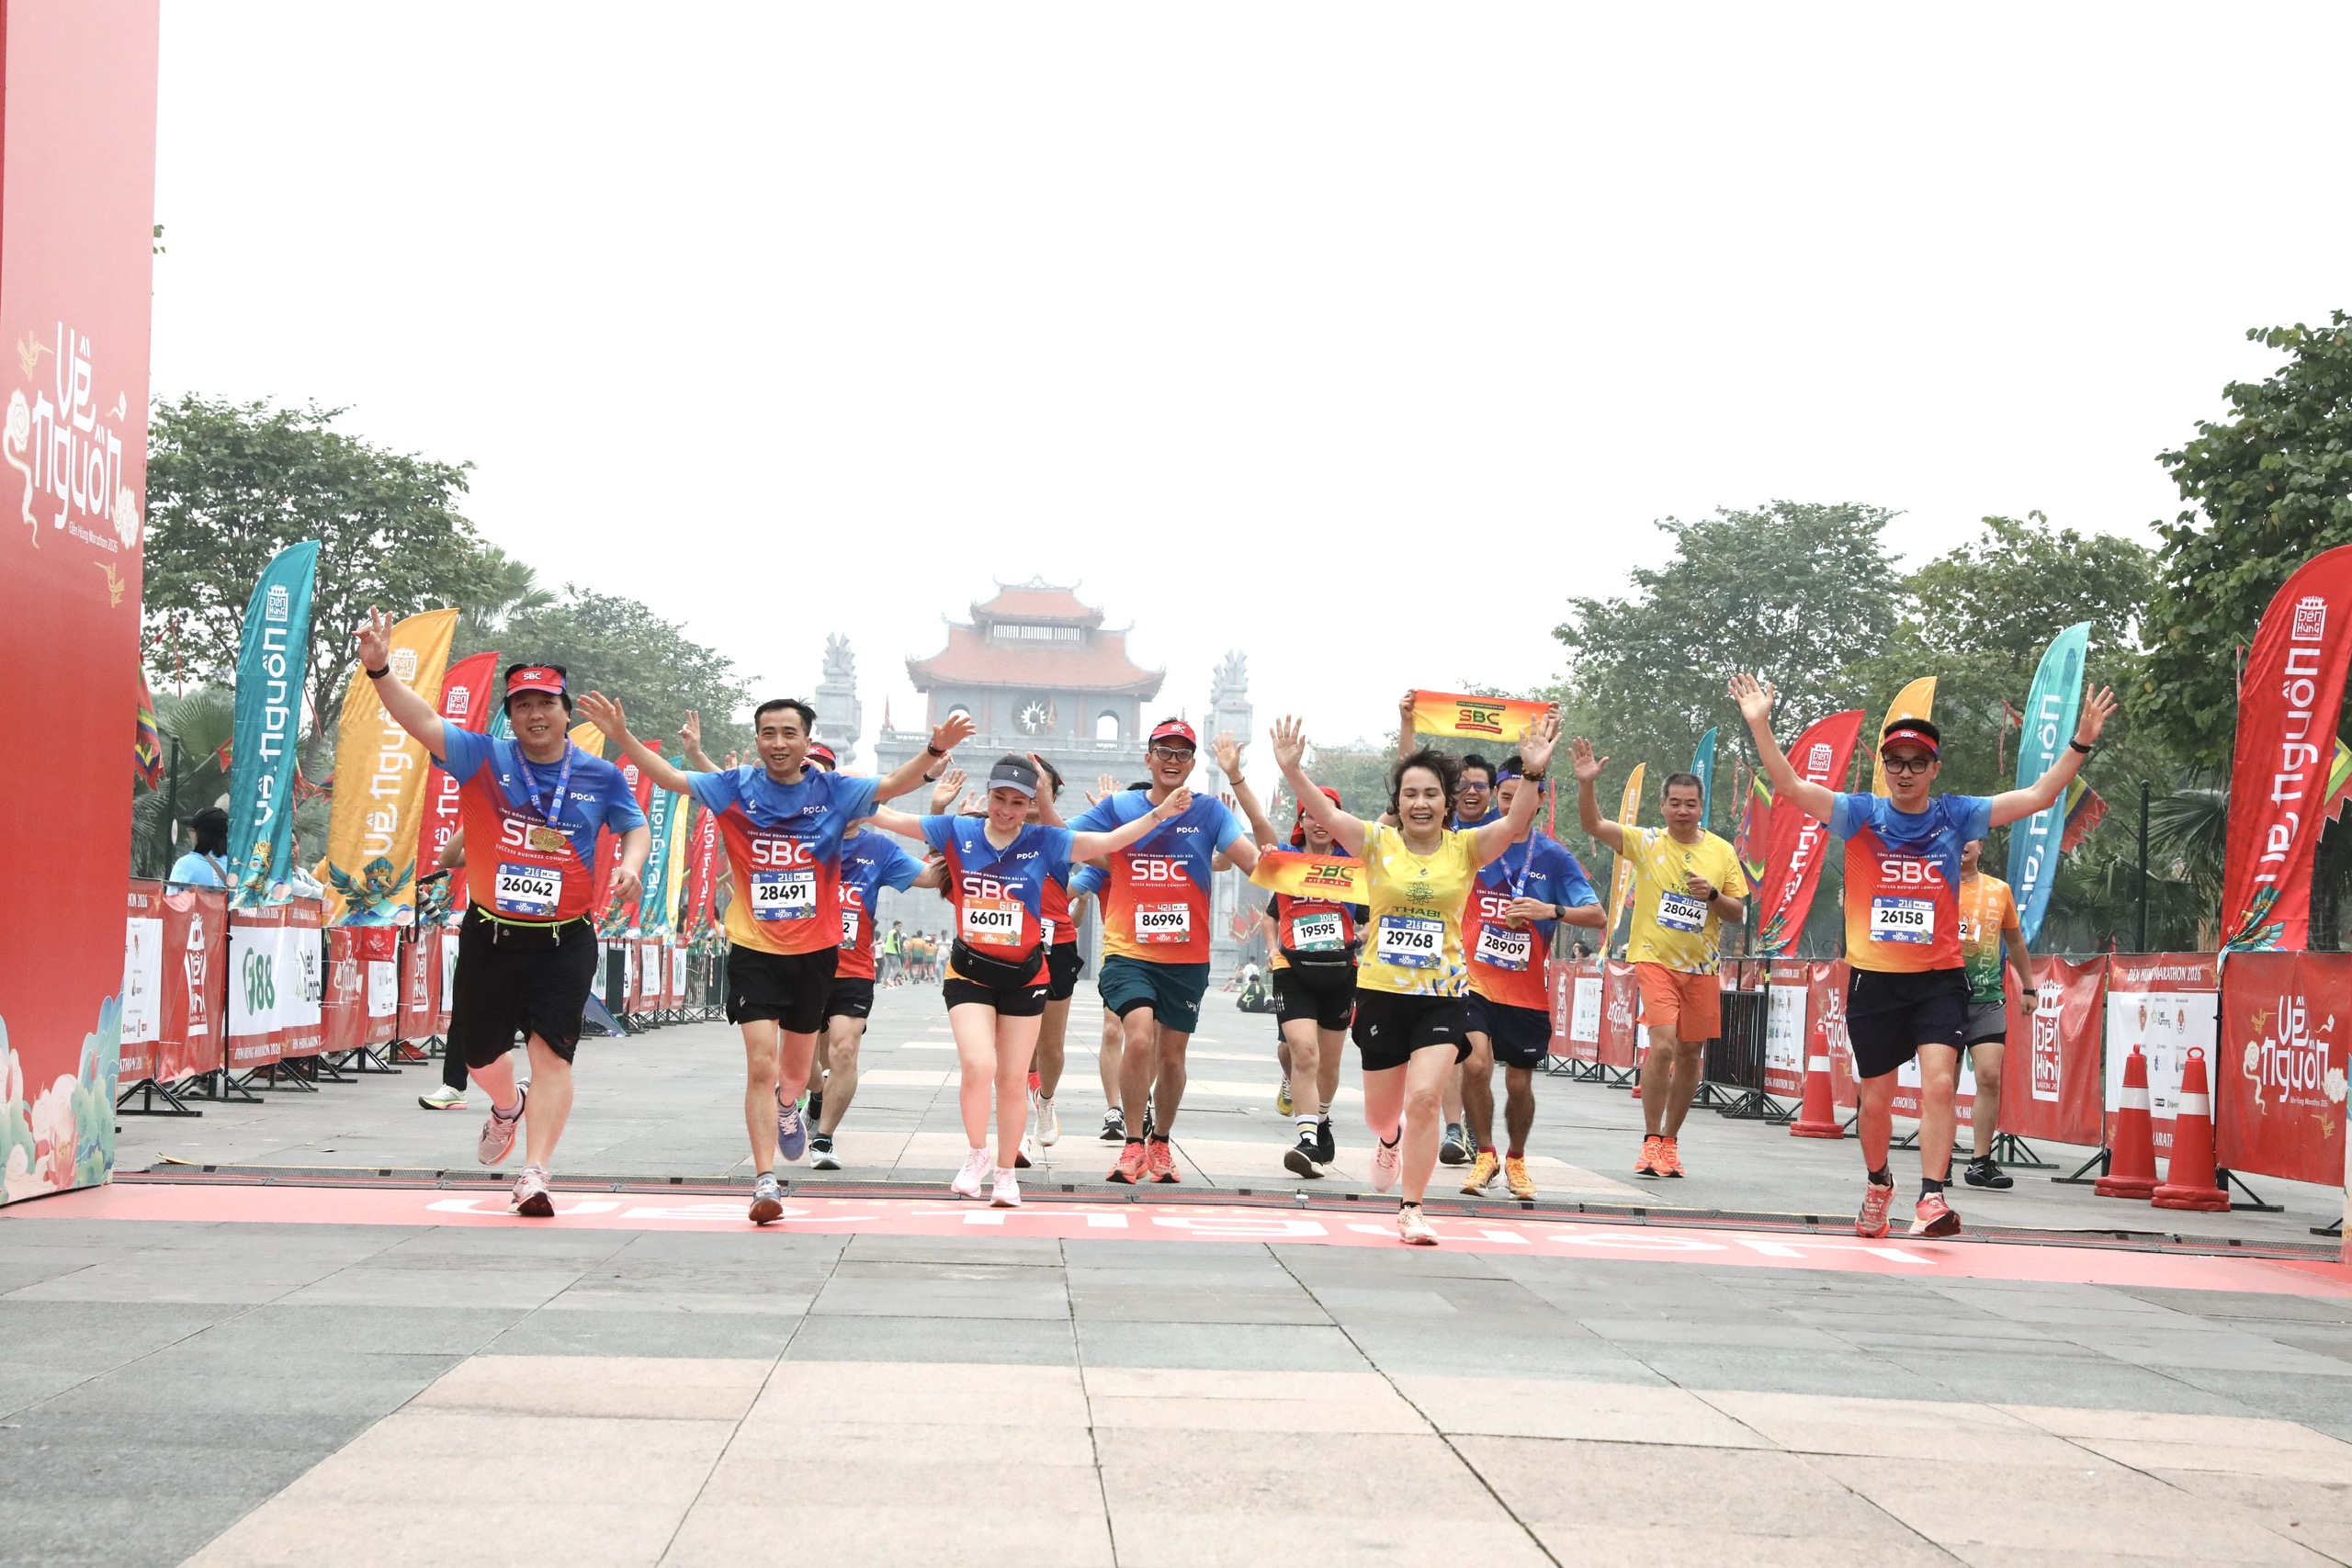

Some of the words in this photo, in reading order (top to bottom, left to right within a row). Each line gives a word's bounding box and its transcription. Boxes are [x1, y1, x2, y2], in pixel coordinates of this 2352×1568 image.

[523, 671, 542, 681] SBC
[1459, 709, 1499, 726] SBC
[517, 851, 544, 860] BUSINESS
[752, 839, 816, 865] SBC
[1131, 859, 1188, 881] SBC
[1307, 863, 1358, 881] SBC
[1881, 860, 1943, 883] SBC
[502, 876, 553, 897] 26042
[760, 885, 806, 900] 28491
[962, 877, 1023, 900] SBC
[838, 885, 863, 907] BC
[970, 911, 1012, 926] 66011
[1393, 906, 1441, 918] THABI
[1663, 902, 1701, 920] 28044
[1880, 910, 1923, 925] 26158
[1142, 914, 1183, 926] 86996
[1300, 924, 1335, 938] 19595
[1386, 930, 1433, 948] 29768
[1484, 936, 1525, 955] 28909
[2187, 967, 2201, 981] 2026
[1892, 1096, 1909, 1109] ATHON
